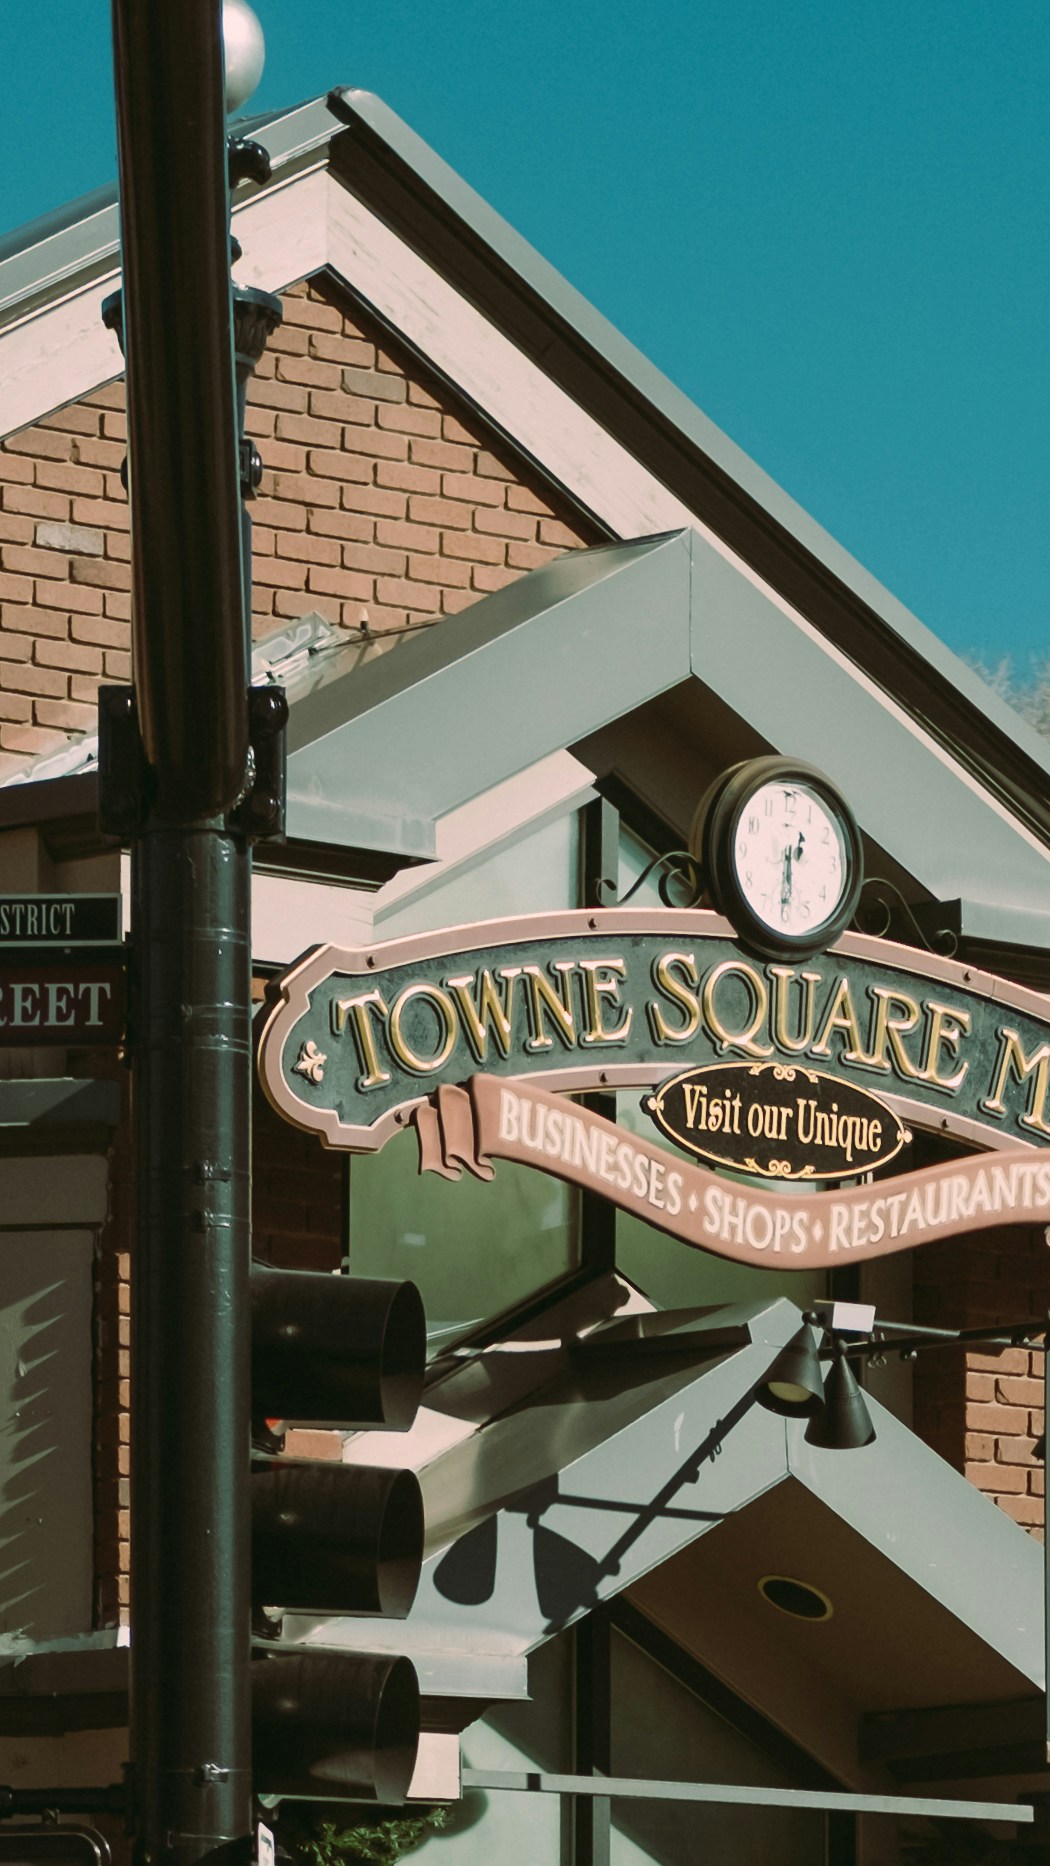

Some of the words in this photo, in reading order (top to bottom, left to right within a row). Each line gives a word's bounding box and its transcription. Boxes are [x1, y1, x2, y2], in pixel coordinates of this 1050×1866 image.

[0, 983, 111, 1026] EET
[337, 958, 633, 1087] TOWNE
[653, 953, 970, 1088] SQUARE
[498, 1088, 683, 1216] BUSINESSES
[703, 1185, 810, 1254] SHOPS
[682, 1084, 742, 1134] Visit
[748, 1103, 793, 1140] our
[797, 1098, 882, 1161] Unique
